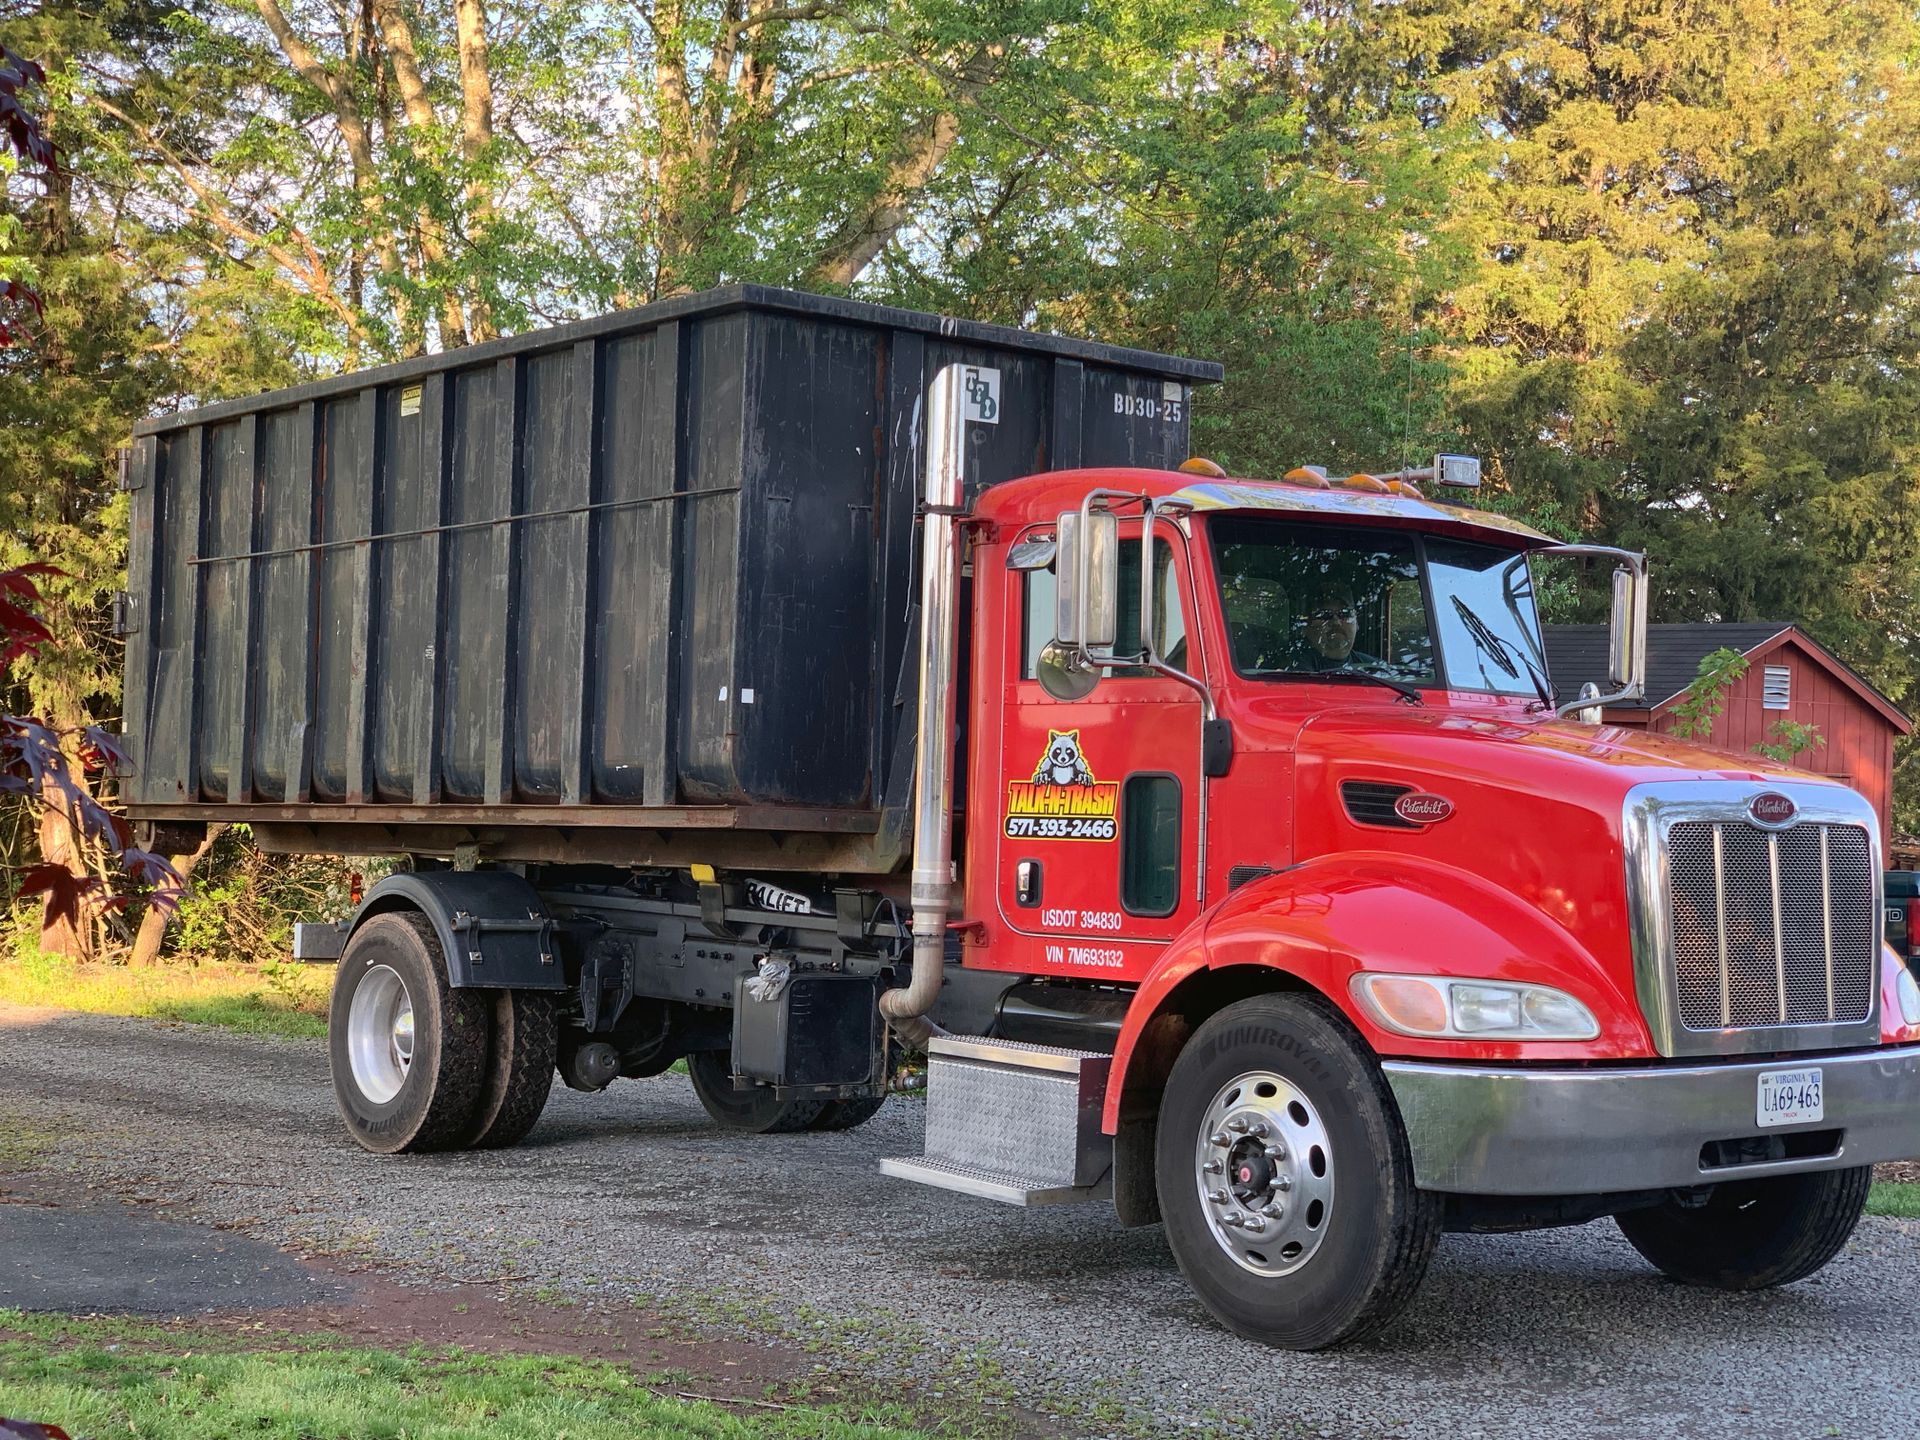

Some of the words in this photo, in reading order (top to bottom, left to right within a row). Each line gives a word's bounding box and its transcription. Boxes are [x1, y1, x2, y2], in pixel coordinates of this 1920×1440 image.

[1114, 393, 1181, 422] BD30-25
[1009, 783, 1117, 815] TALK-N-TRASH
[1401, 798, 1447, 815] Peterbilt
[1757, 798, 1791, 815] Peterbilt
[1007, 818, 1114, 838] 571-393-2466
[1041, 909, 1077, 928] USDOT
[1080, 911, 1122, 930] 394830
[1045, 945, 1064, 963] VIN
[1067, 947, 1124, 968] 7M693132
[1775, 1073, 1806, 1084] VIRGINIA
